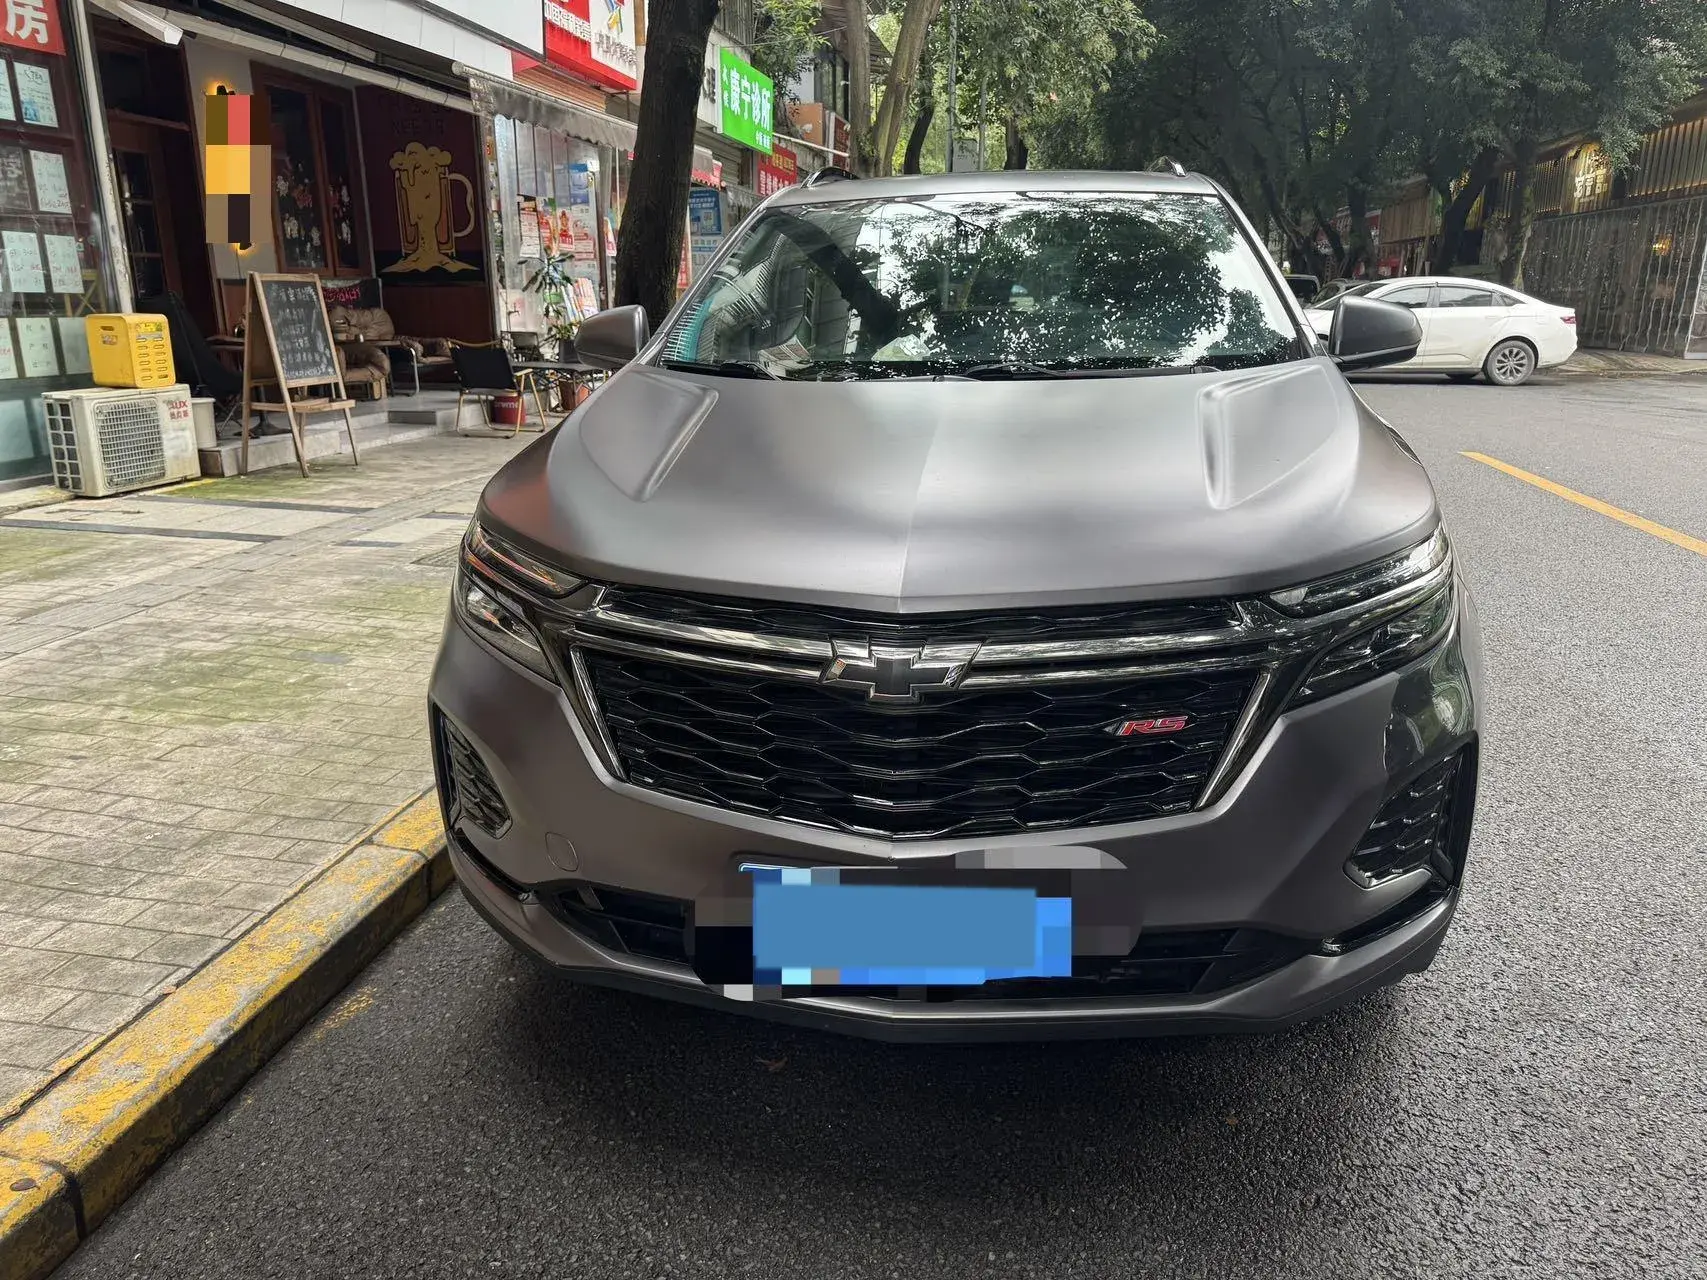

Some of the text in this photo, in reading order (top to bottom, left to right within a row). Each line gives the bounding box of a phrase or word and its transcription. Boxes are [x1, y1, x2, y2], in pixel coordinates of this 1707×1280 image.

[5, 0, 49, 44] 房
[730, 67, 771, 131] 康宁诊所
[1117, 716, 1188, 736] RS
